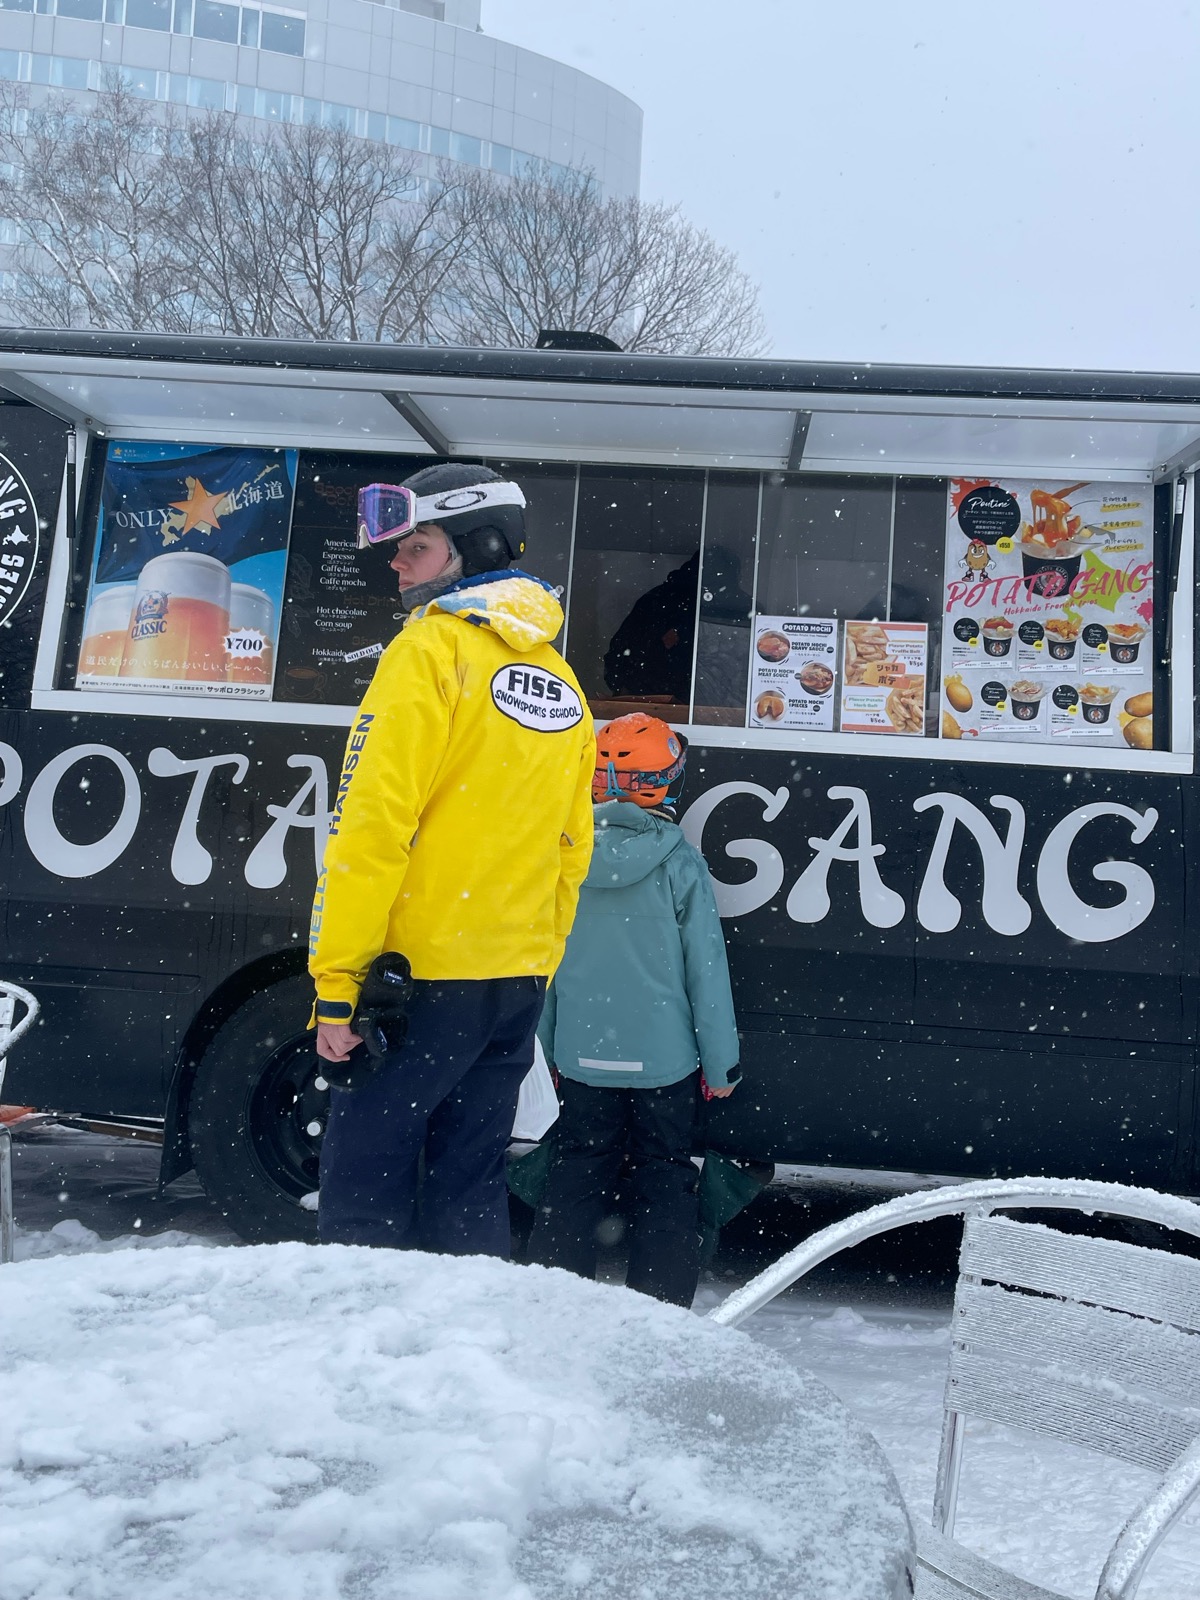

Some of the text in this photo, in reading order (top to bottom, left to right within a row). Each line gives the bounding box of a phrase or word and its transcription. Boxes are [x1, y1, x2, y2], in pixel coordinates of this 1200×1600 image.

[0, 475, 27, 519] NG
[225, 480, 285, 513] 北海道
[115, 508, 174, 529] ONLY
[322, 551, 356, 561] Espresso
[320, 576, 367, 587] Caffe mocha
[945, 570, 1065, 612] POTATO
[1069, 558, 1153, 600] GANG
[316, 606, 368, 616] Hot chocolate
[1003, 605, 1042, 616] Hokkaido
[1044, 600, 1075, 610] French
[131, 619, 168, 640] CLASSIC
[315, 619, 353, 629] Corn soup
[226, 637, 263, 651] ¥700
[312, 648, 347, 657] Hokkaido
[347, 649, 366, 661] SOLD
[365, 645, 381, 656] OUT
[507, 668, 563, 703] FISS
[495, 689, 581, 719] SNOWSPORTS SCHOOL
[308, 713, 375, 956] HELLY HANSEN
[679, 781, 1159, 943] GANG
